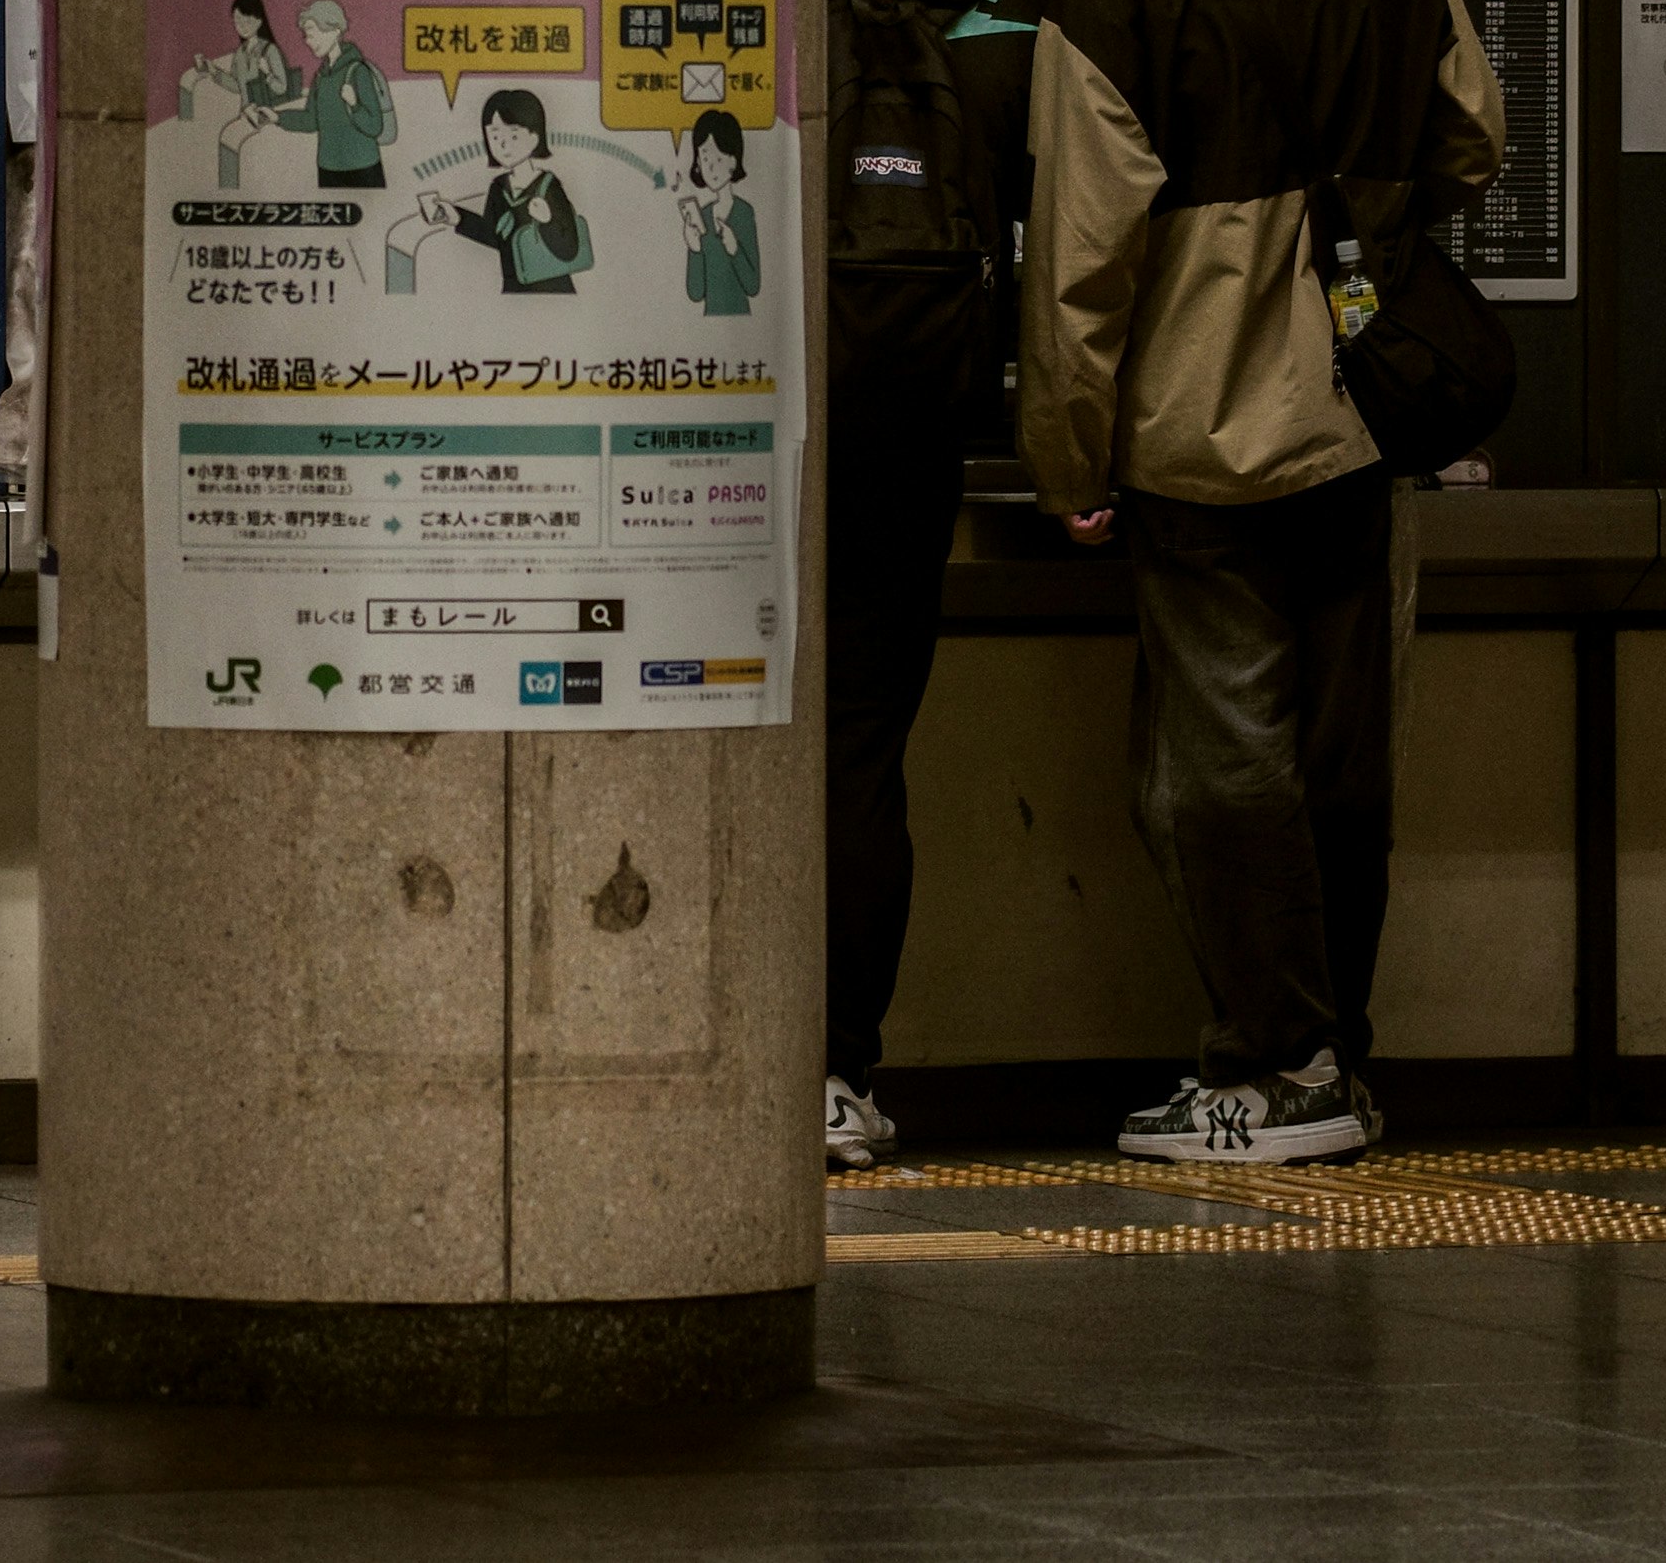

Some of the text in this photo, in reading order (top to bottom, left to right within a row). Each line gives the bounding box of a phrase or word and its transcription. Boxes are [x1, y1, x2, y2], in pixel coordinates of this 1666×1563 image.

[414, 25, 571, 55] 改札を通過
[854, 156, 923, 176] JANSPORT
[185, 245, 345, 269] 18歳以上の方も
[185, 356, 773, 392] 改札通過をメールやアプリでお知らせします。
[318, 430, 446, 450] サービスプラン
[633, 429, 758, 448] ご利用可能なカード
[421, 465, 519, 481] ご家族へ通知
[622, 485, 695, 505] Suica
[708, 484, 767, 503] PASMO
[296, 609, 356, 626] 詳しくは
[382, 606, 518, 627] まもレール
[206, 658, 262, 694] JR
[359, 674, 476, 695] 都営交通
[641, 663, 703, 685] CSP
[1205, 1096, 1255, 1152] NY
